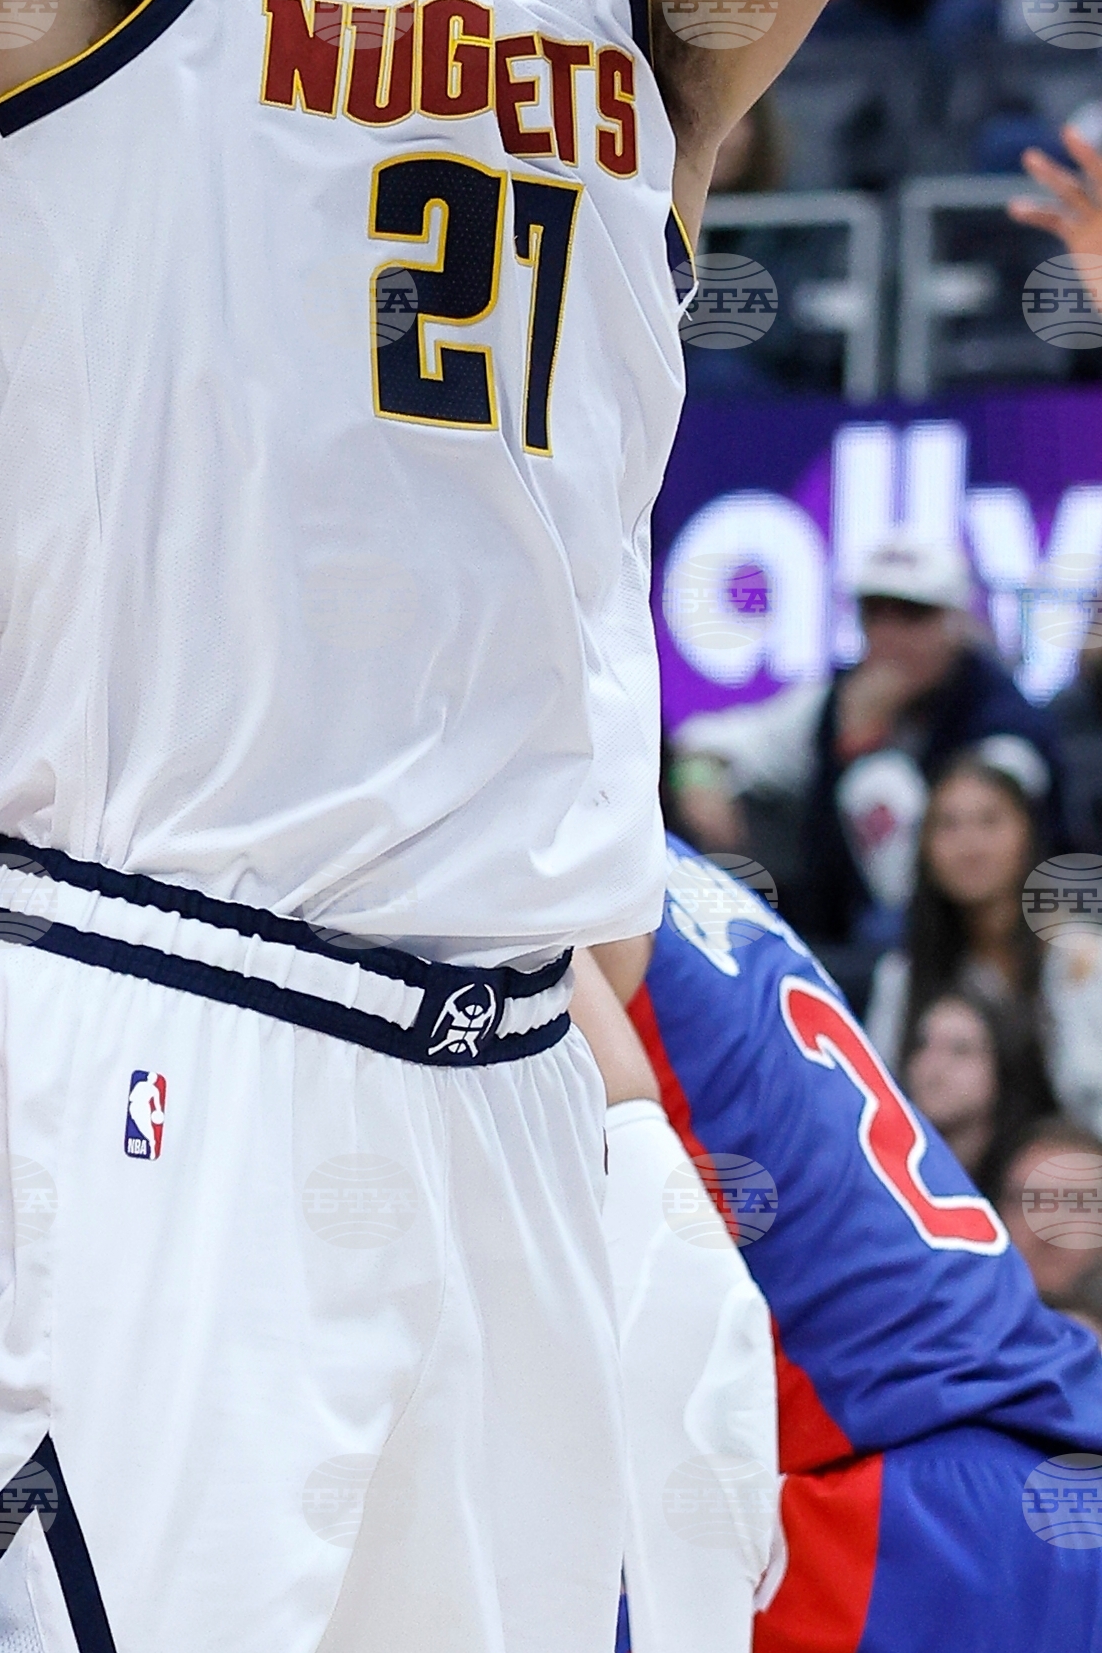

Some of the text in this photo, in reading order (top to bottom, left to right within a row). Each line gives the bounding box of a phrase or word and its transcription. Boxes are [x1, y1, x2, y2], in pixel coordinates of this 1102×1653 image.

[368, 151, 585, 458] 27
[126, 1137, 148, 1156] NBA
[780, 975, 1009, 1256] 2
